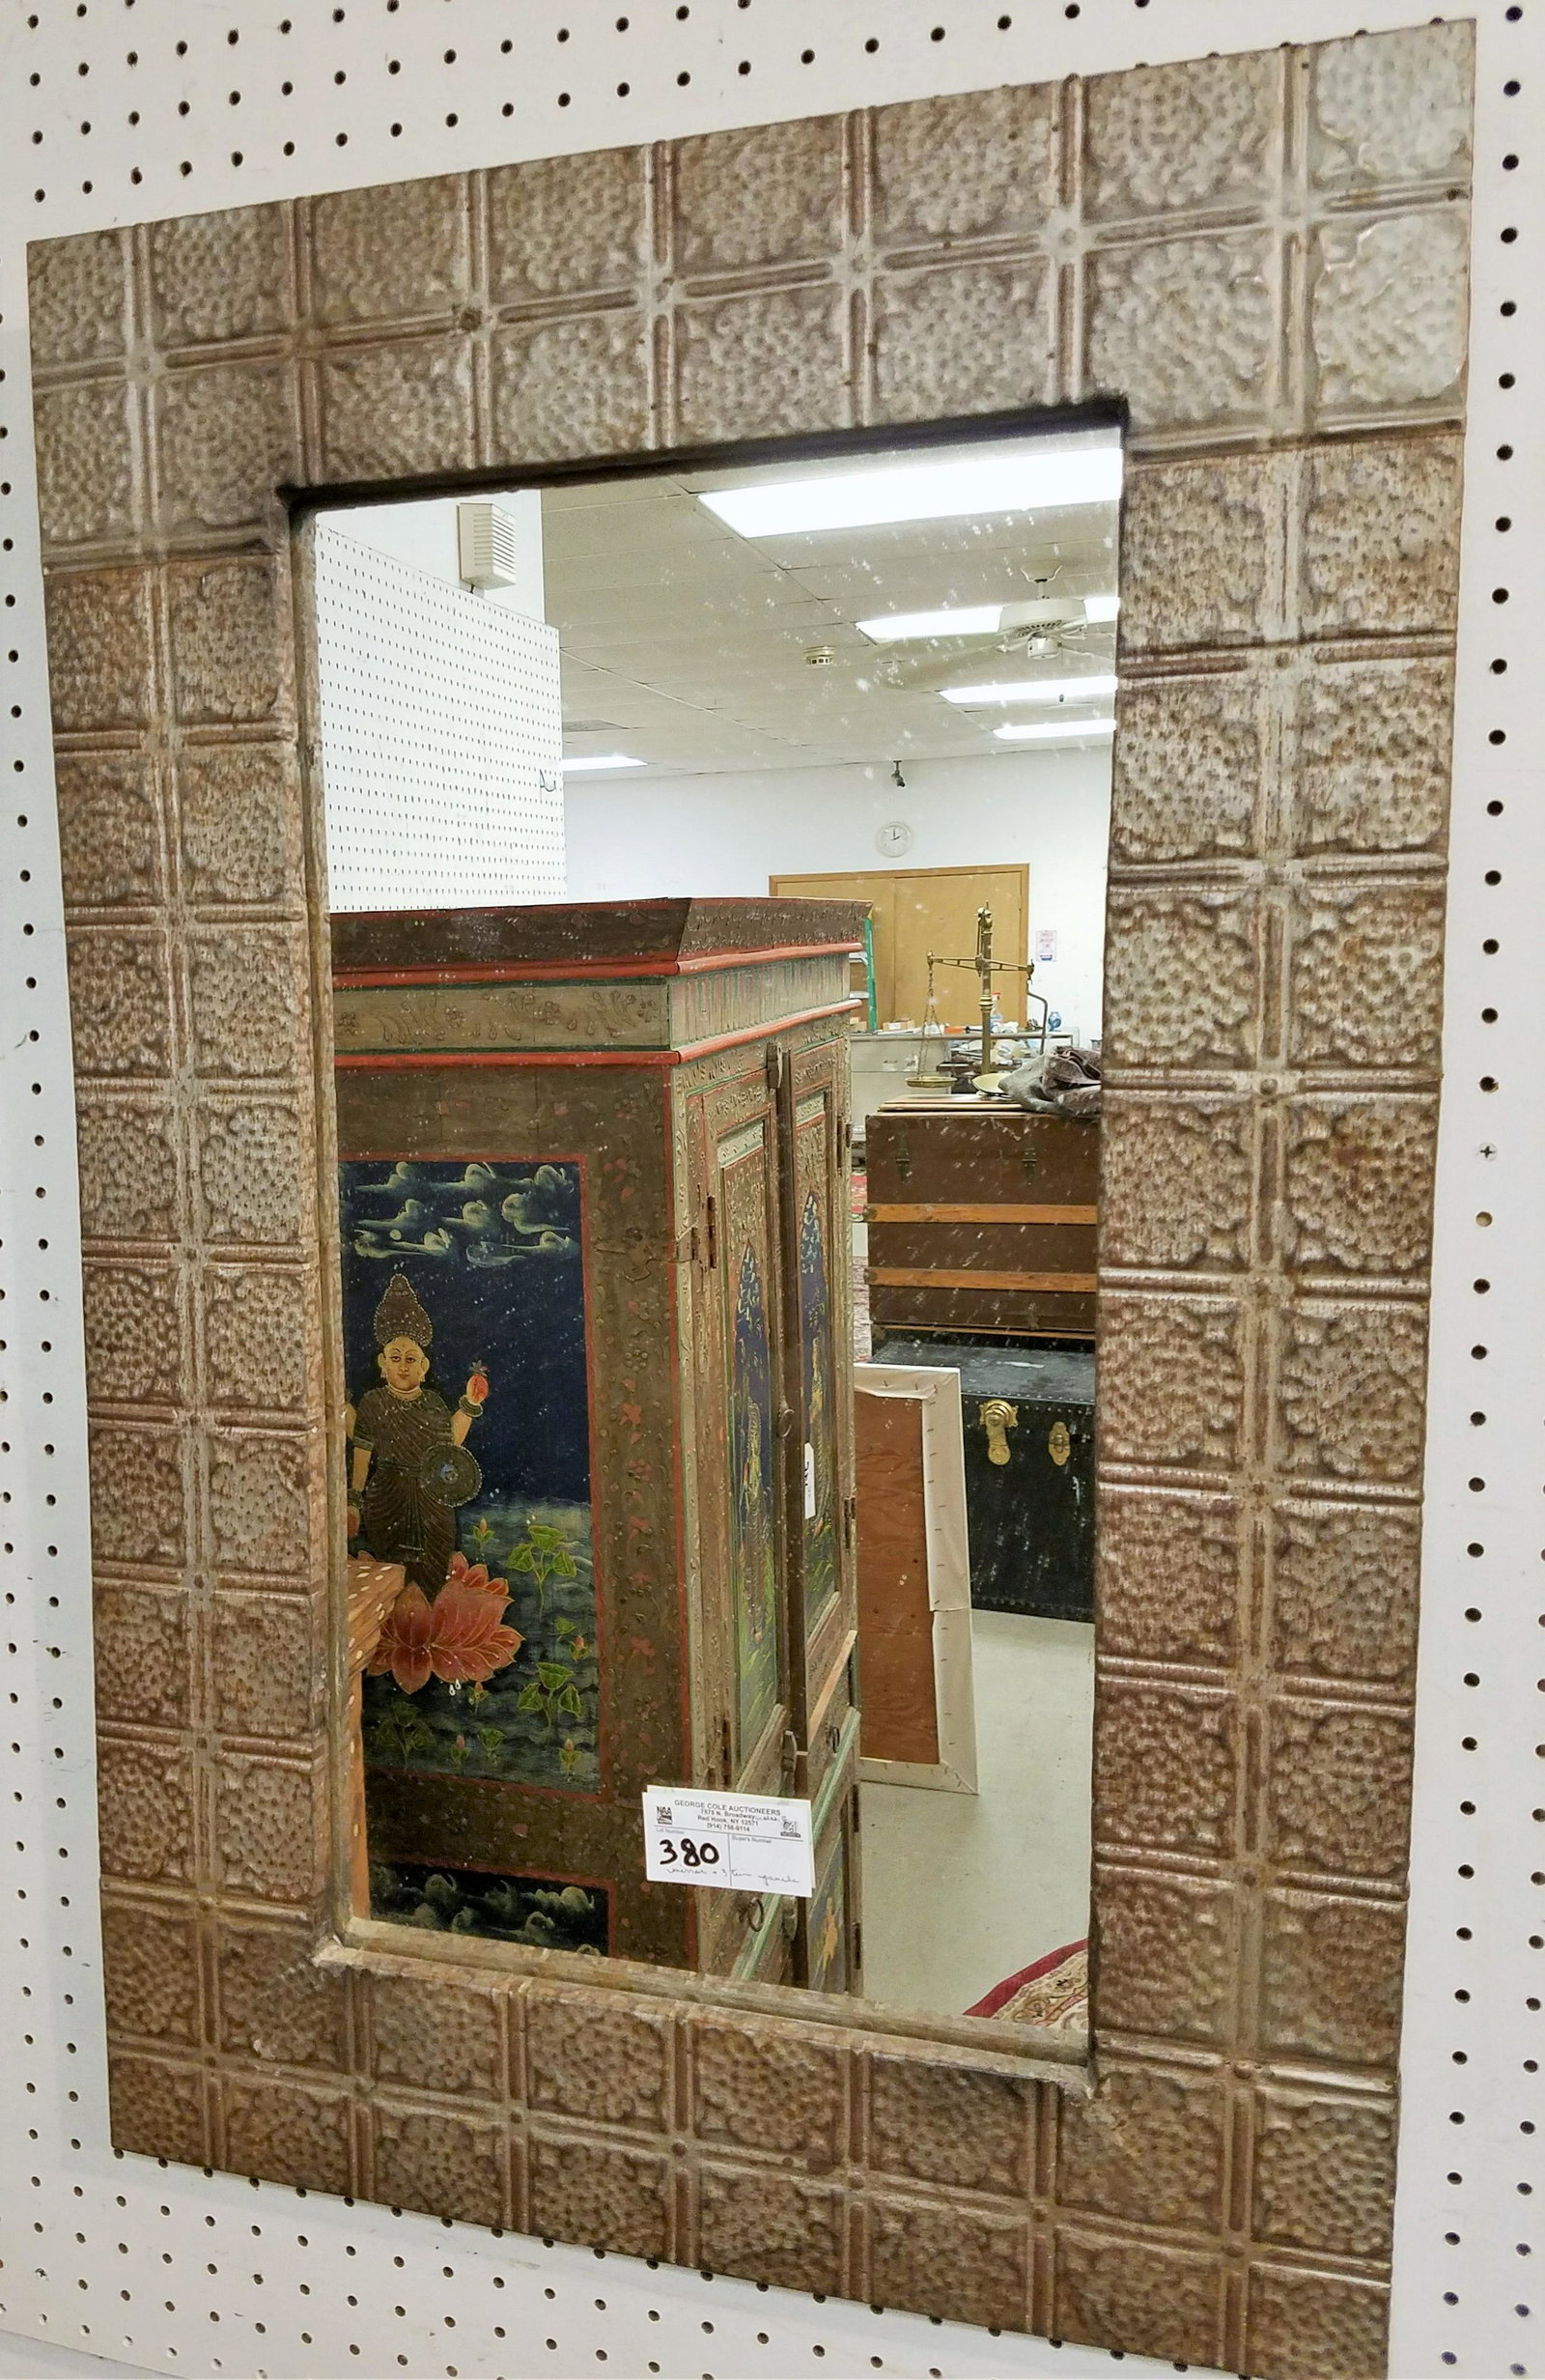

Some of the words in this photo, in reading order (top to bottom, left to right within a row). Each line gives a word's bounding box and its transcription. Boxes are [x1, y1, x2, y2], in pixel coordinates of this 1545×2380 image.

[657, 1805, 672, 1815] NAA
[674, 1799, 705, 1808] GEORGE
[707, 1802, 726, 1811] COLE
[729, 1805, 781, 1816] AUCTIONEERS
[660, 1838, 719, 1867] 380
